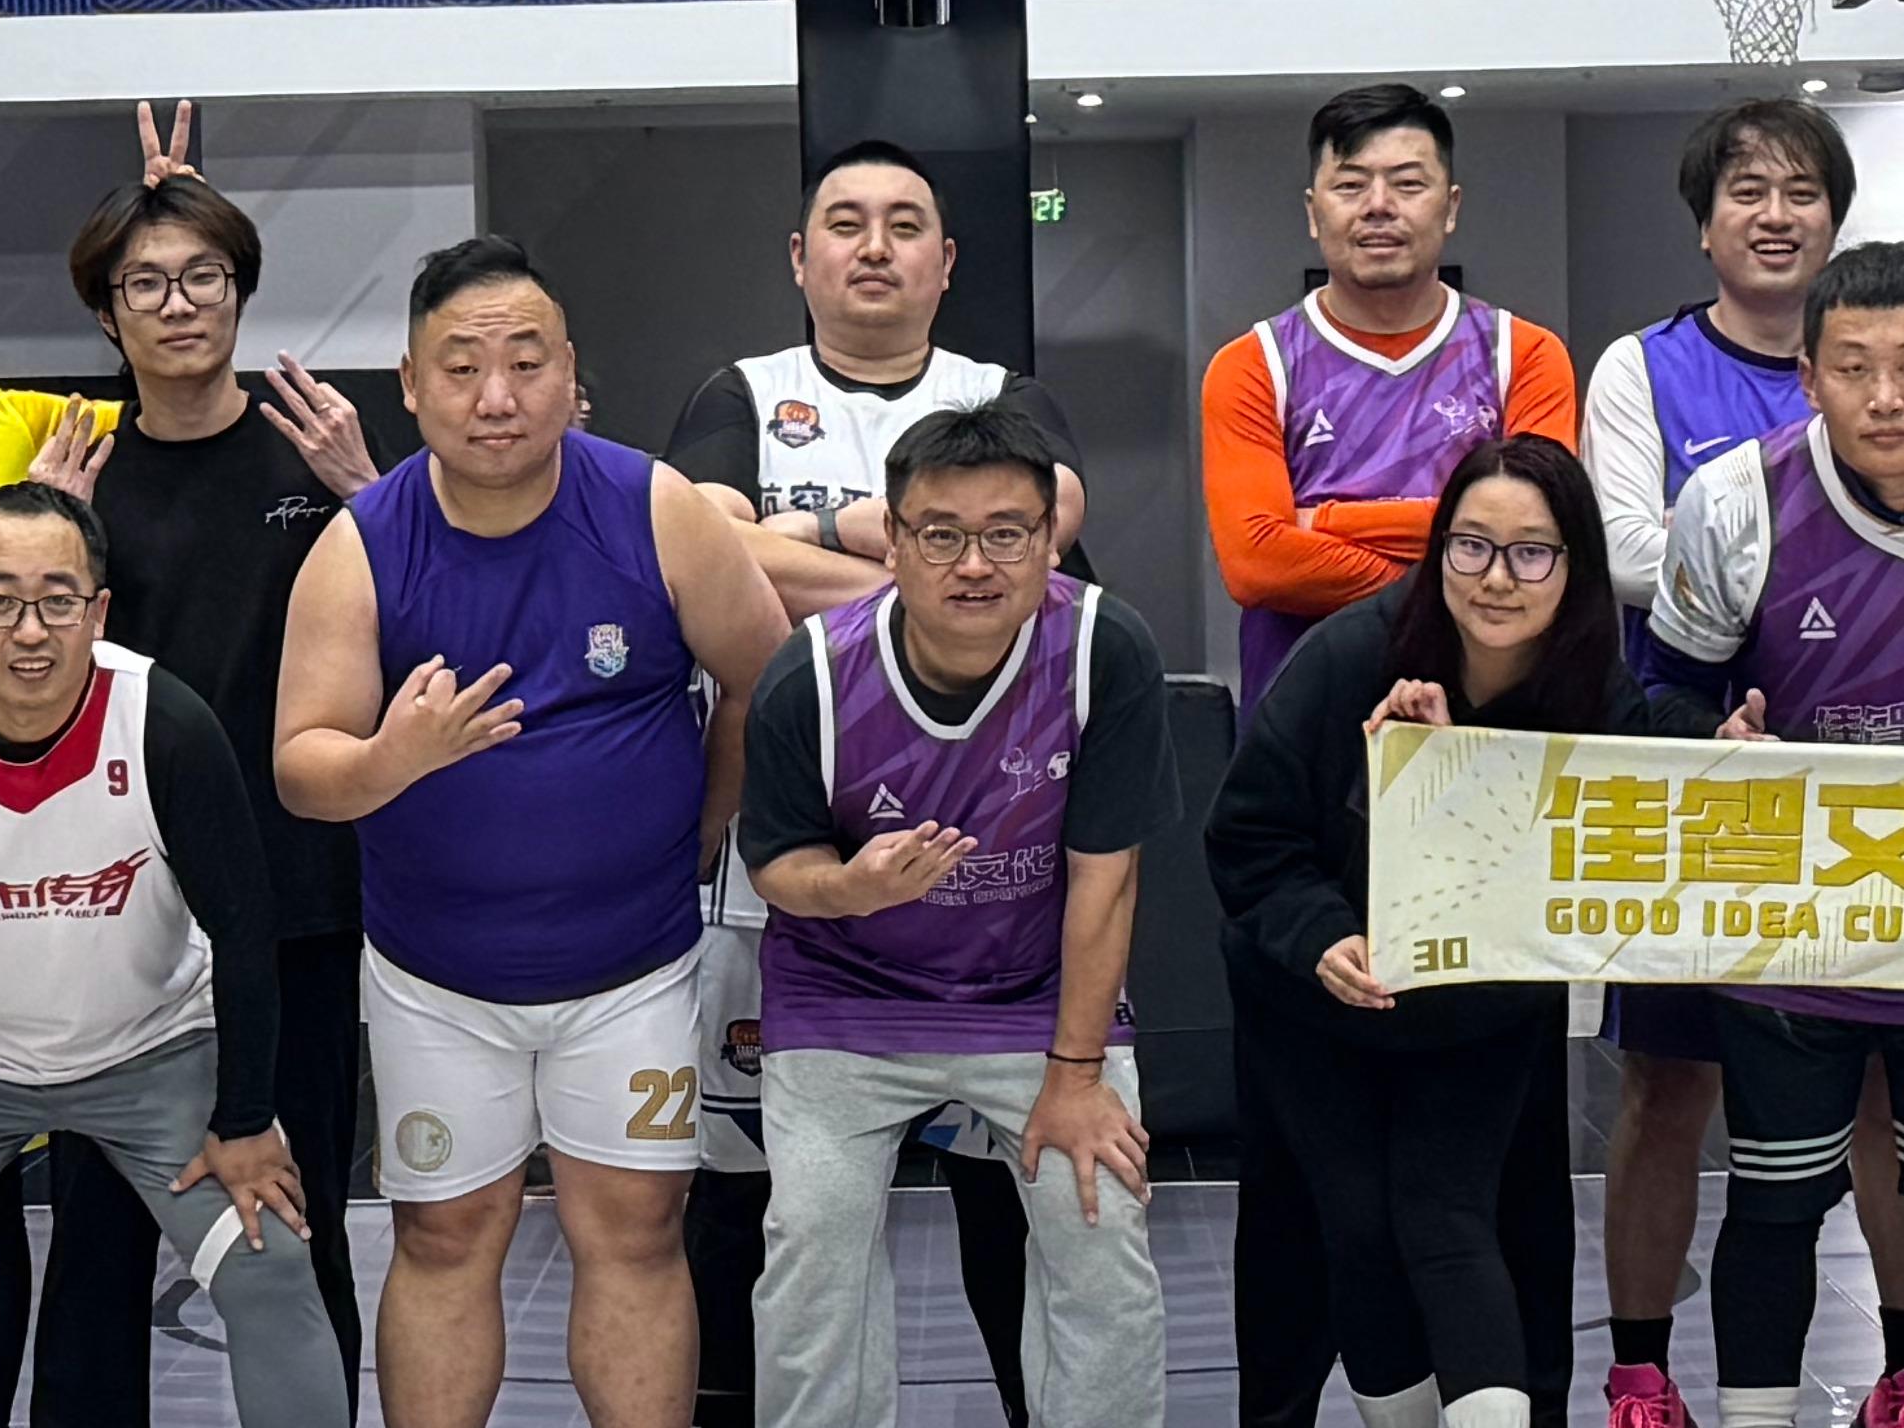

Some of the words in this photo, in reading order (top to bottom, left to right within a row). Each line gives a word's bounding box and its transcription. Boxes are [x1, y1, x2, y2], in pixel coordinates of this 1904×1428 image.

[107, 758, 130, 797] 9
[934, 843, 1057, 892] 文化
[1545, 896, 1680, 936] GOOD
[1702, 899, 1821, 940] IDEA
[1412, 937, 1469, 973] 30
[626, 1065, 697, 1140] 22
